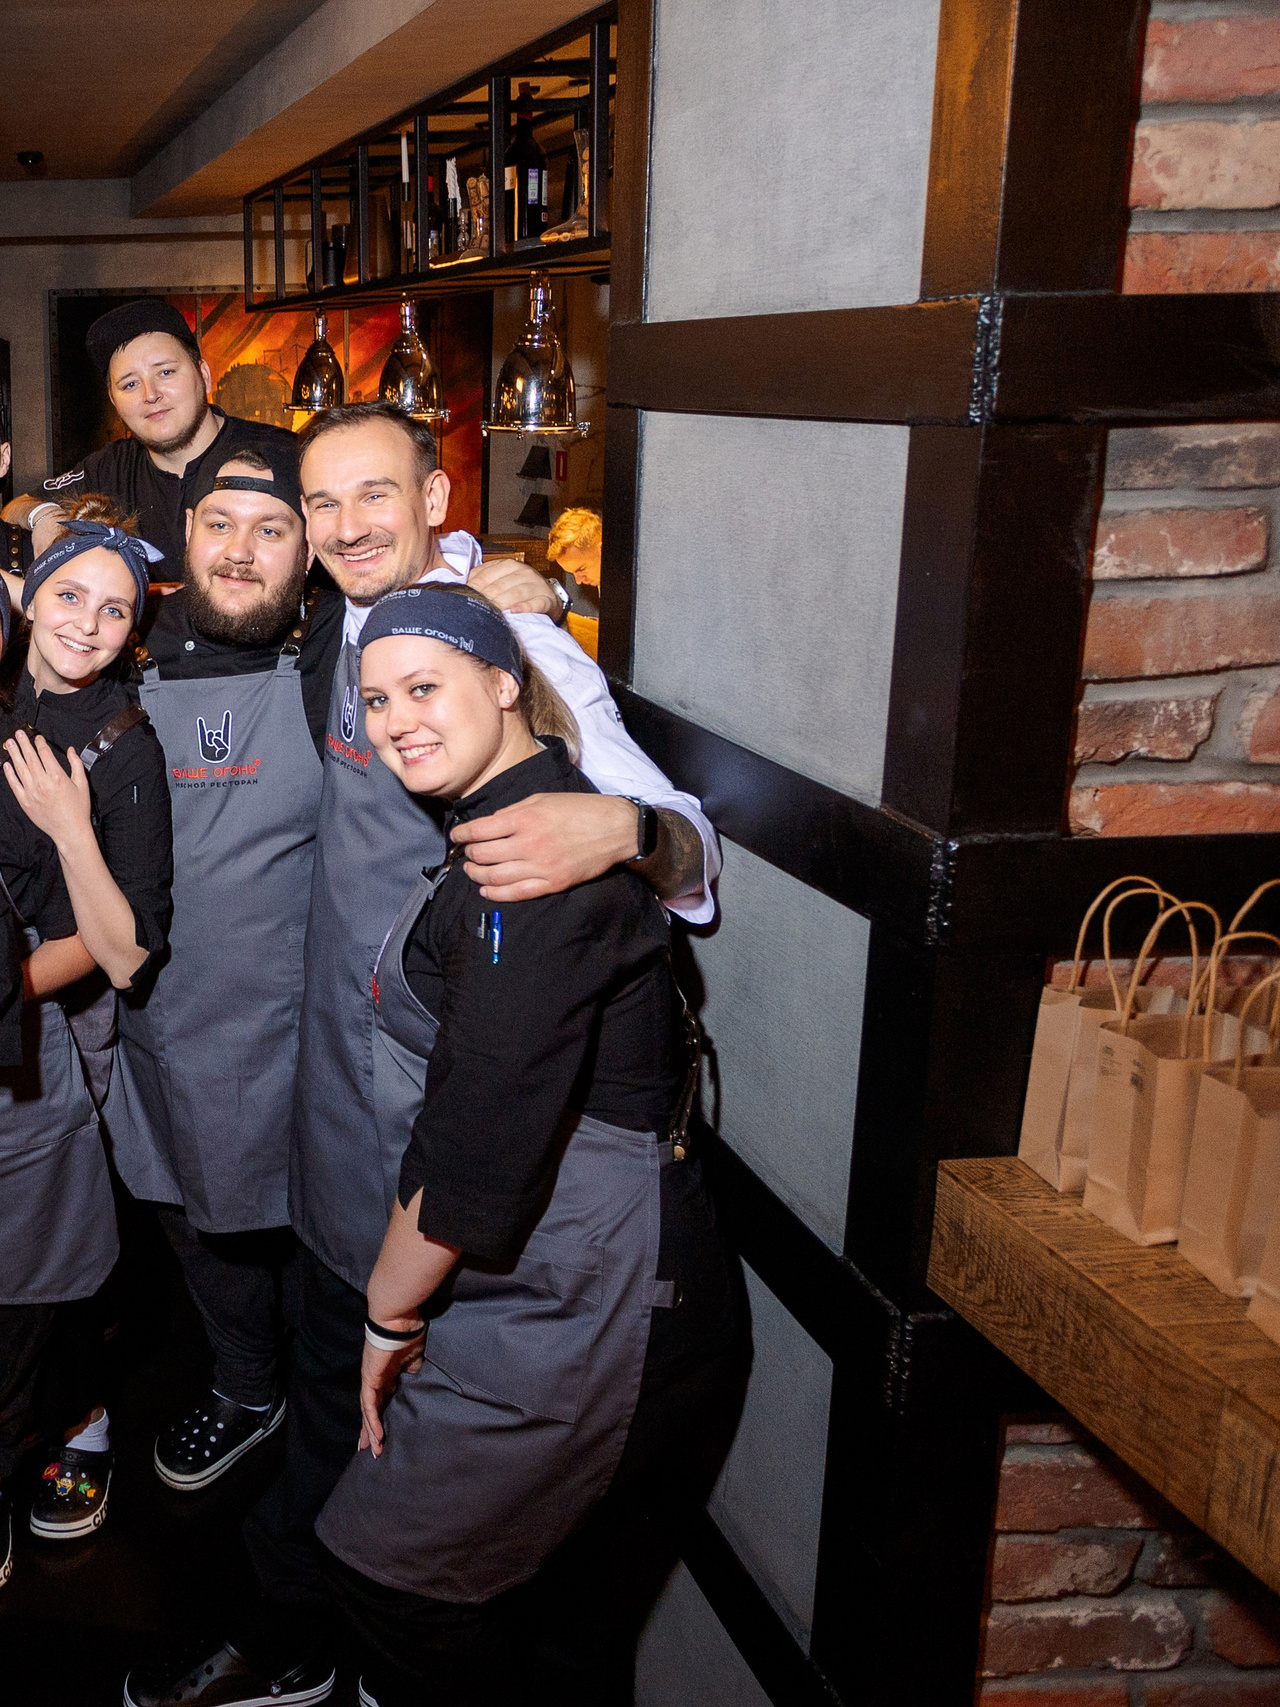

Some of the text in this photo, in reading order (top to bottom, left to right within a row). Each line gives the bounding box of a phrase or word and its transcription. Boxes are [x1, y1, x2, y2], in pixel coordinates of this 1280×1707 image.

[391, 627, 459, 644] ВАШЕ ОГОНЬ
[172, 767, 208, 779] ВАШЕ
[210, 778, 258, 788] РЕСТОРАН
